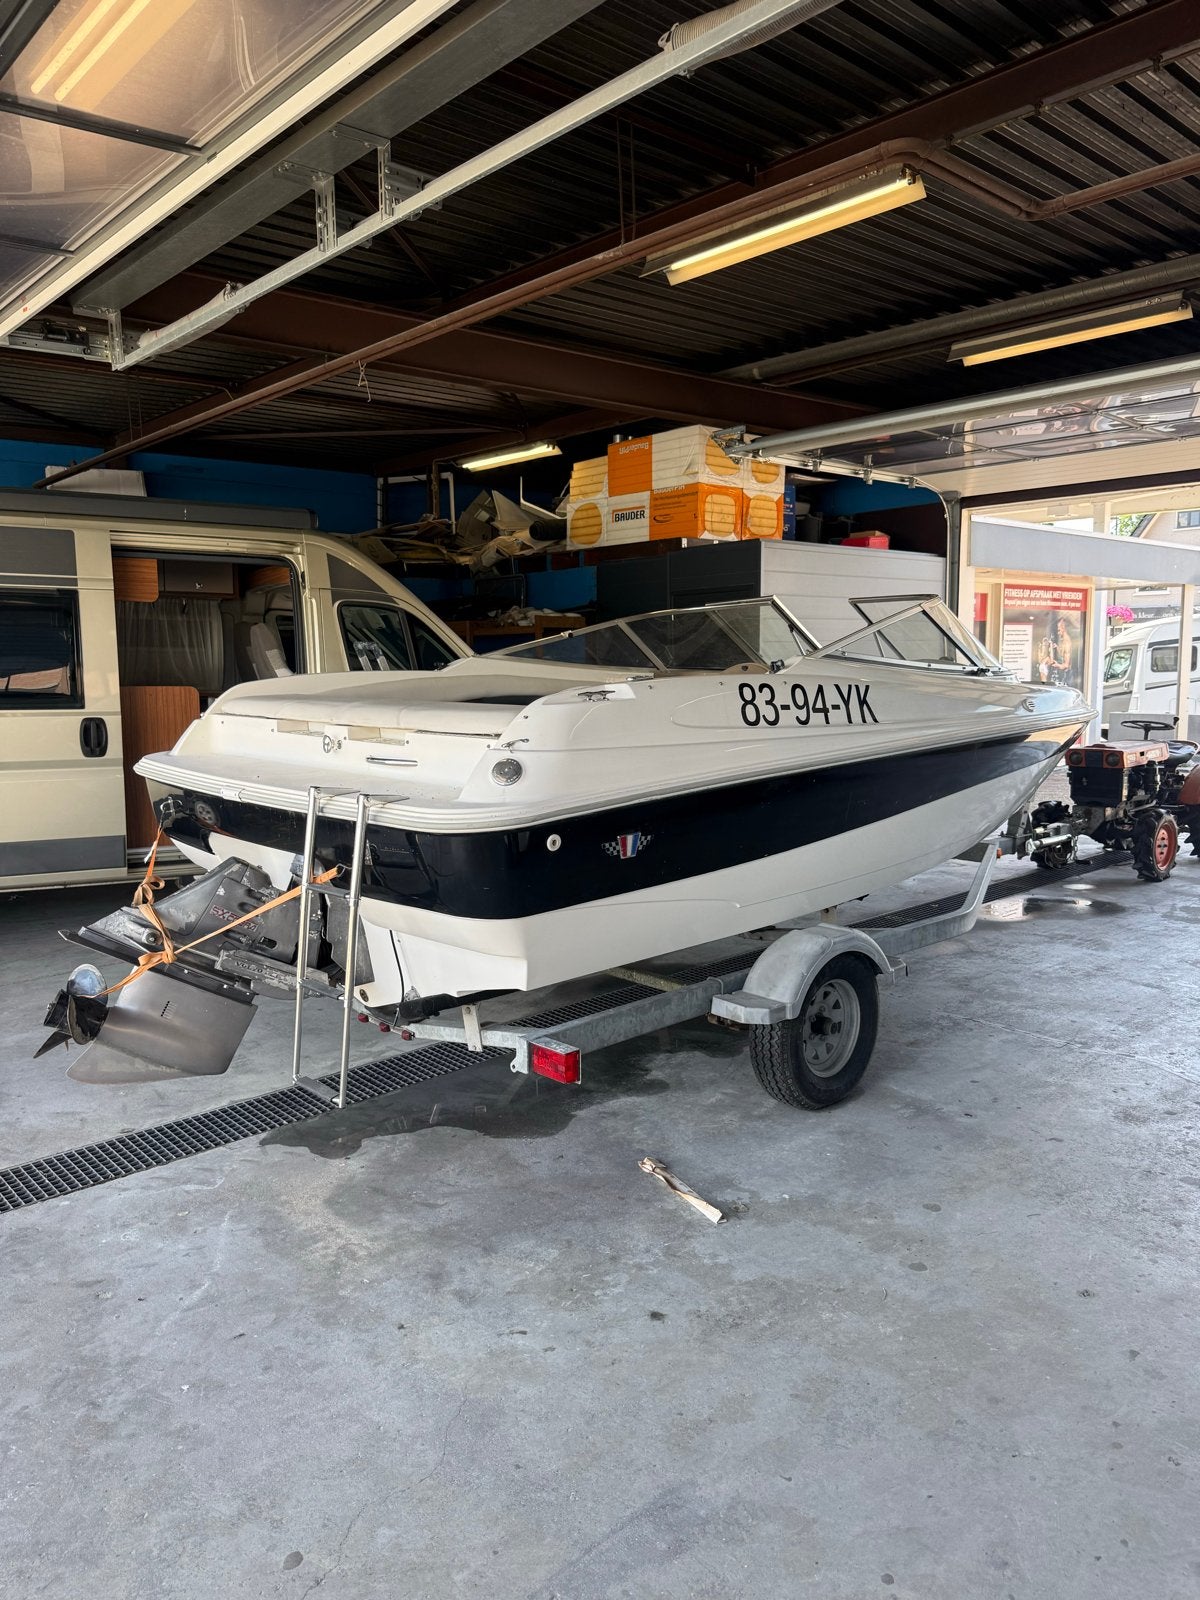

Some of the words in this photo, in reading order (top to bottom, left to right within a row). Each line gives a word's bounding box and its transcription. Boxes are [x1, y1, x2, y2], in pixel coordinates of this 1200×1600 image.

[614, 510, 645, 522] BAUDER
[1004, 588, 1023, 598] FITNESS
[738, 682, 879, 726] 83-94-YK
